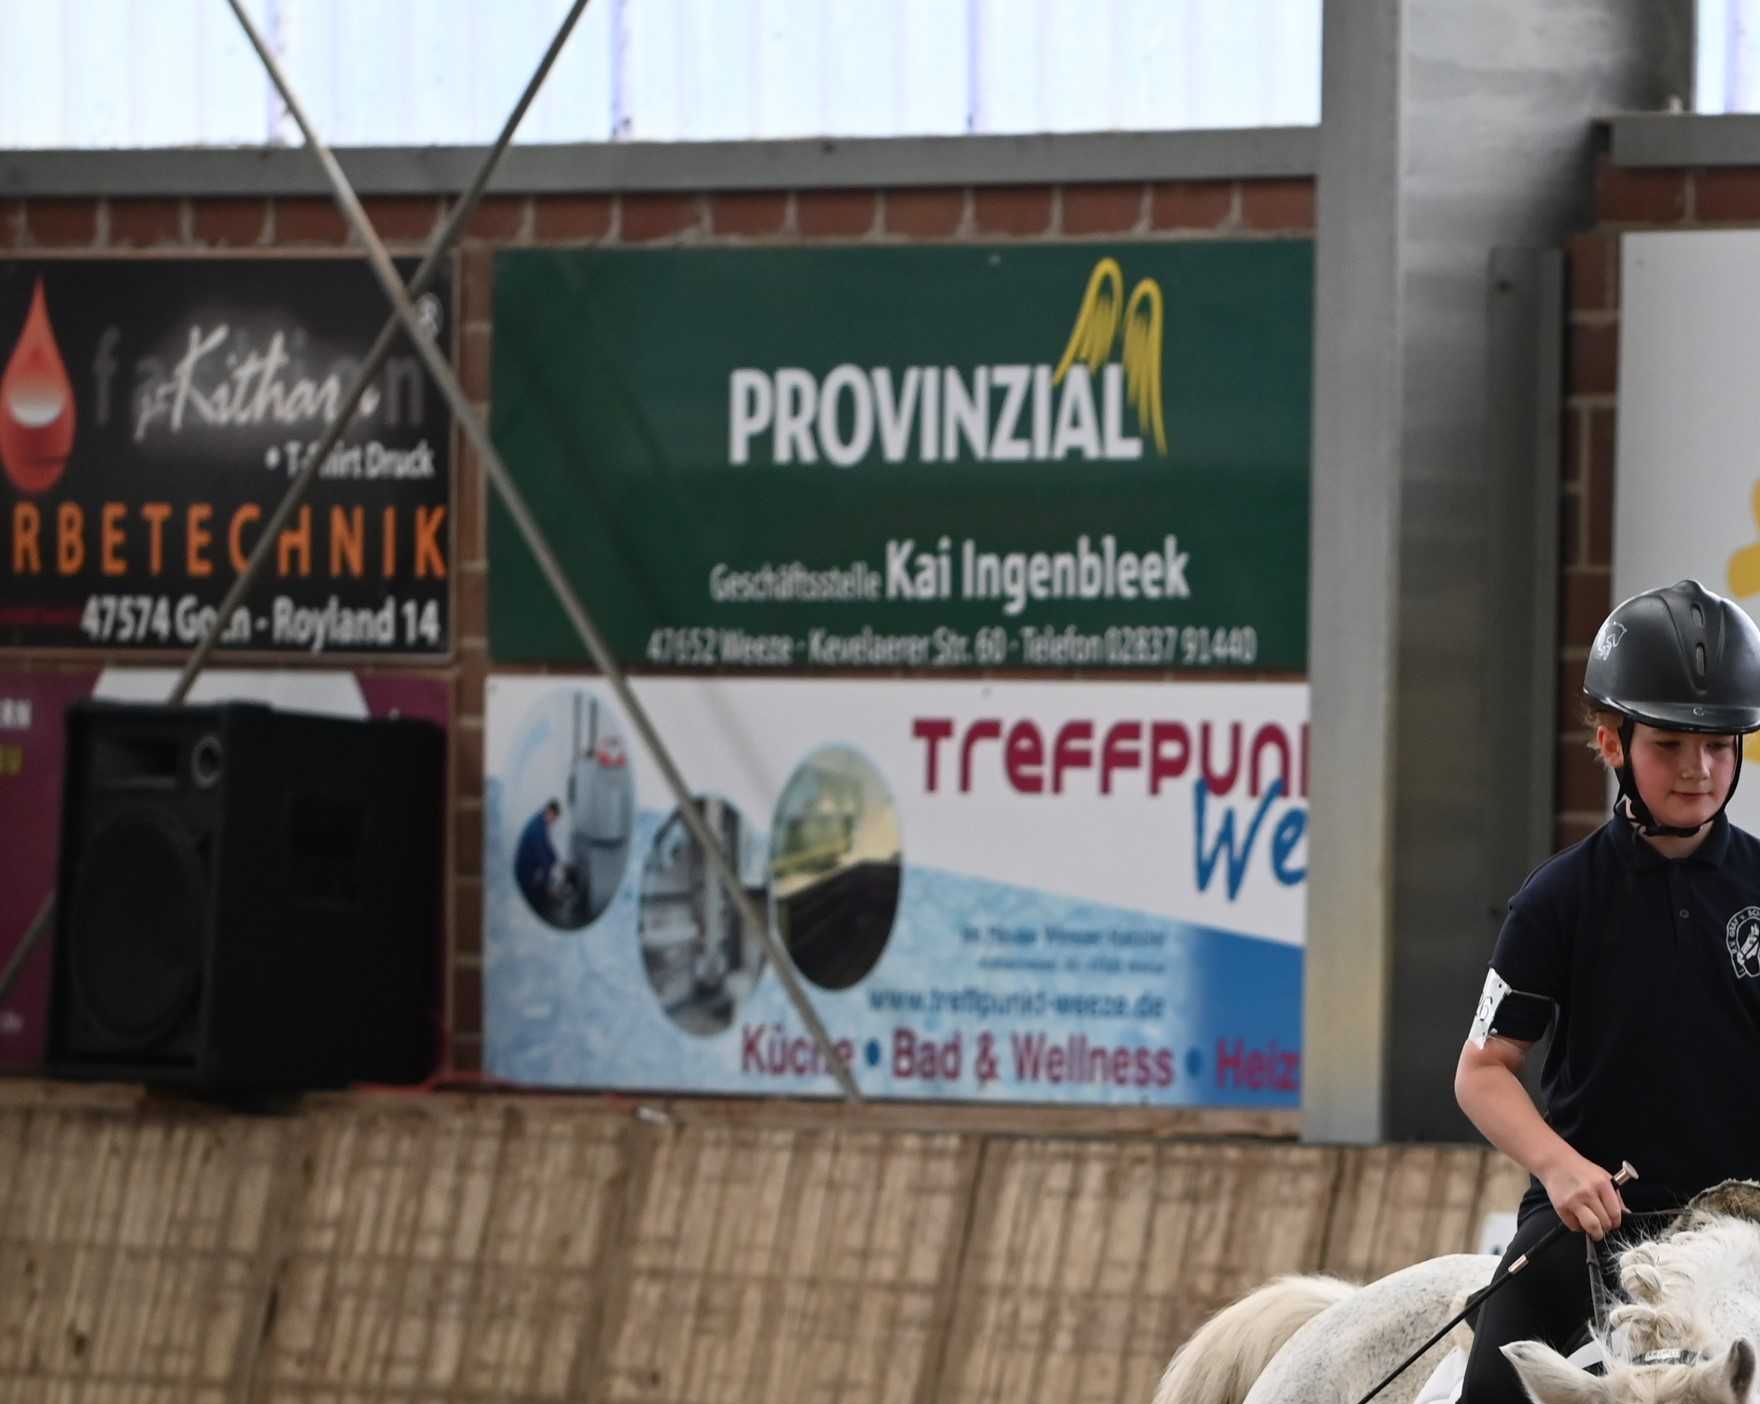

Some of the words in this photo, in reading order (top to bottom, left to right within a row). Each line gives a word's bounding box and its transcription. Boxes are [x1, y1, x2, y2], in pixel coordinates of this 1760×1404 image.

[729, 363, 1143, 467] PROVINZIAL
[366, 438, 434, 479] Druck
[12, 503, 448, 577] RBETECHNIK
[709, 561, 881, 601] Geschäftsstelle
[886, 535, 951, 599] Kai
[962, 534, 1190, 615] Ingenbleek
[80, 595, 170, 641] 47574
[272, 595, 395, 656] Royland
[402, 599, 440, 645] 14
[932, 625, 973, 665] Str.
[975, 626, 1007, 664] 60
[1020, 625, 1103, 664] Telefon
[1194, 777, 1308, 902] We
[891, 1028, 963, 1080] Bad
[974, 1029, 999, 1081] &
[1010, 1031, 1173, 1088] Wellness
